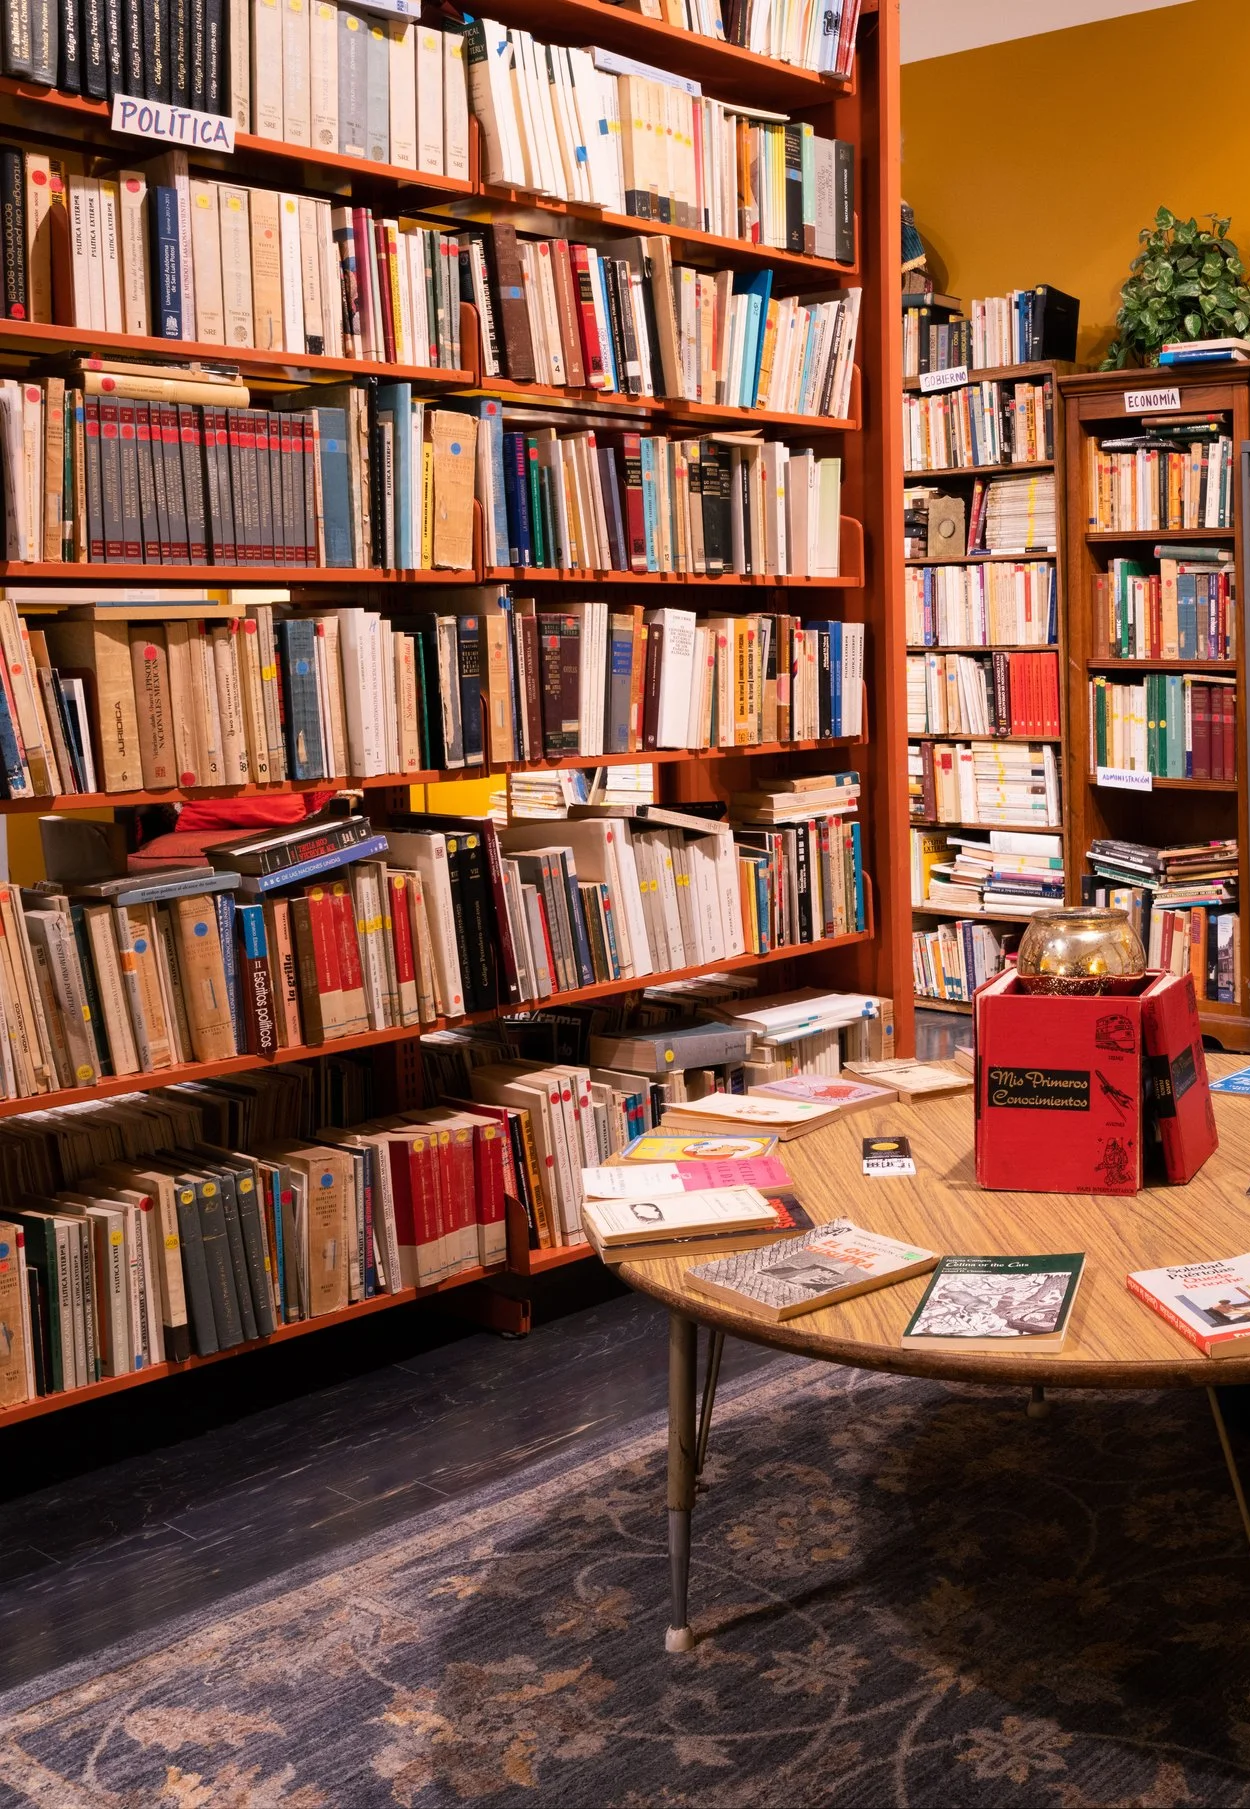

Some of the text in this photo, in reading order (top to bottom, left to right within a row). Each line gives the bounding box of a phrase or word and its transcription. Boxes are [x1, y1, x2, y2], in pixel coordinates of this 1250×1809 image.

[67, 34, 75, 61] Código
[120, 101, 230, 148] POLÍTICA
[168, 245, 176, 263] Potosí
[163, 244, 172, 306] Universidad Autónoma
[170, 285, 176, 293] de
[555, 365, 561, 373] 4
[924, 371, 967, 387] GOBIERNO
[1128, 390, 1177, 409] ECONOMÍA
[144, 659, 153, 691] EPISODI
[152, 659, 165, 749] NACIONALES MEXICAN
[114, 700, 126, 757] JURIDICA
[121, 771, 128, 782] 6
[210, 763, 217, 772] 3
[258, 764, 267, 773] 10
[299, 862, 323, 876] NACIONES
[323, 856, 341, 868] UNIDAS
[253, 971, 273, 1048] Escritos políticos
[990, 1070, 1088, 1089] Mis Primeros
[993, 1089, 1088, 1108] Conocimientos
[805, 1243, 878, 1272] SUSURRA
[821, 1239, 881, 1260] EL QUE
[944, 1260, 977, 1270] Celina
[1007, 1260, 1030, 1269] Cats
[1166, 1261, 1225, 1275] Soledad
[1167, 1265, 1236, 1281] Puértolas
[1183, 1272, 1234, 1286] Queda
[1183, 1276, 1245, 1291] la noche
